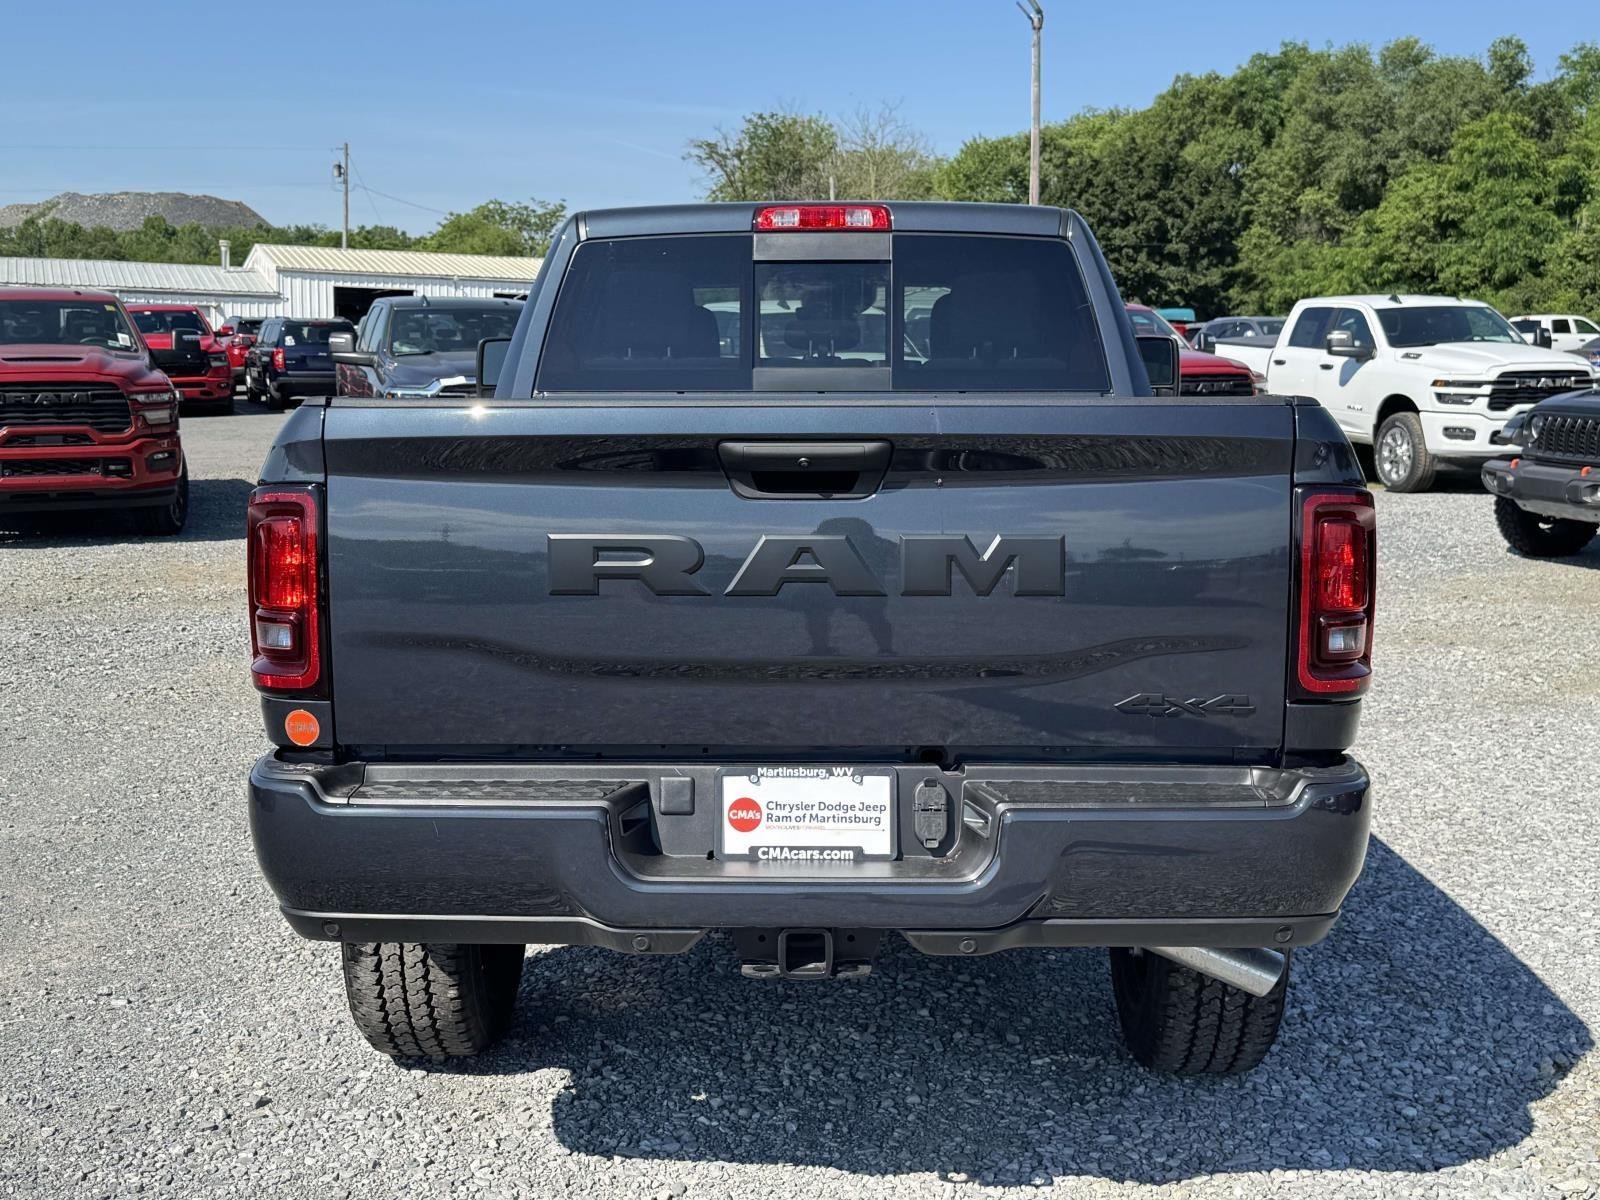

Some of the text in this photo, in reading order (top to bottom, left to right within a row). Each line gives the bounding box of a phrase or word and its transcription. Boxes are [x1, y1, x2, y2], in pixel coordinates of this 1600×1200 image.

[1520, 377, 1573, 388] RAM
[4, 391, 89, 404] RAM
[547, 532, 1066, 597] RAM
[757, 767, 854, 779] Martinsburg, WV
[729, 809, 761, 820] CMA's
[766, 801, 887, 815] Chrysler Dodge Jeep
[766, 813, 882, 826] Ram of Martinsburg
[757, 846, 854, 860] CMAcars.com
